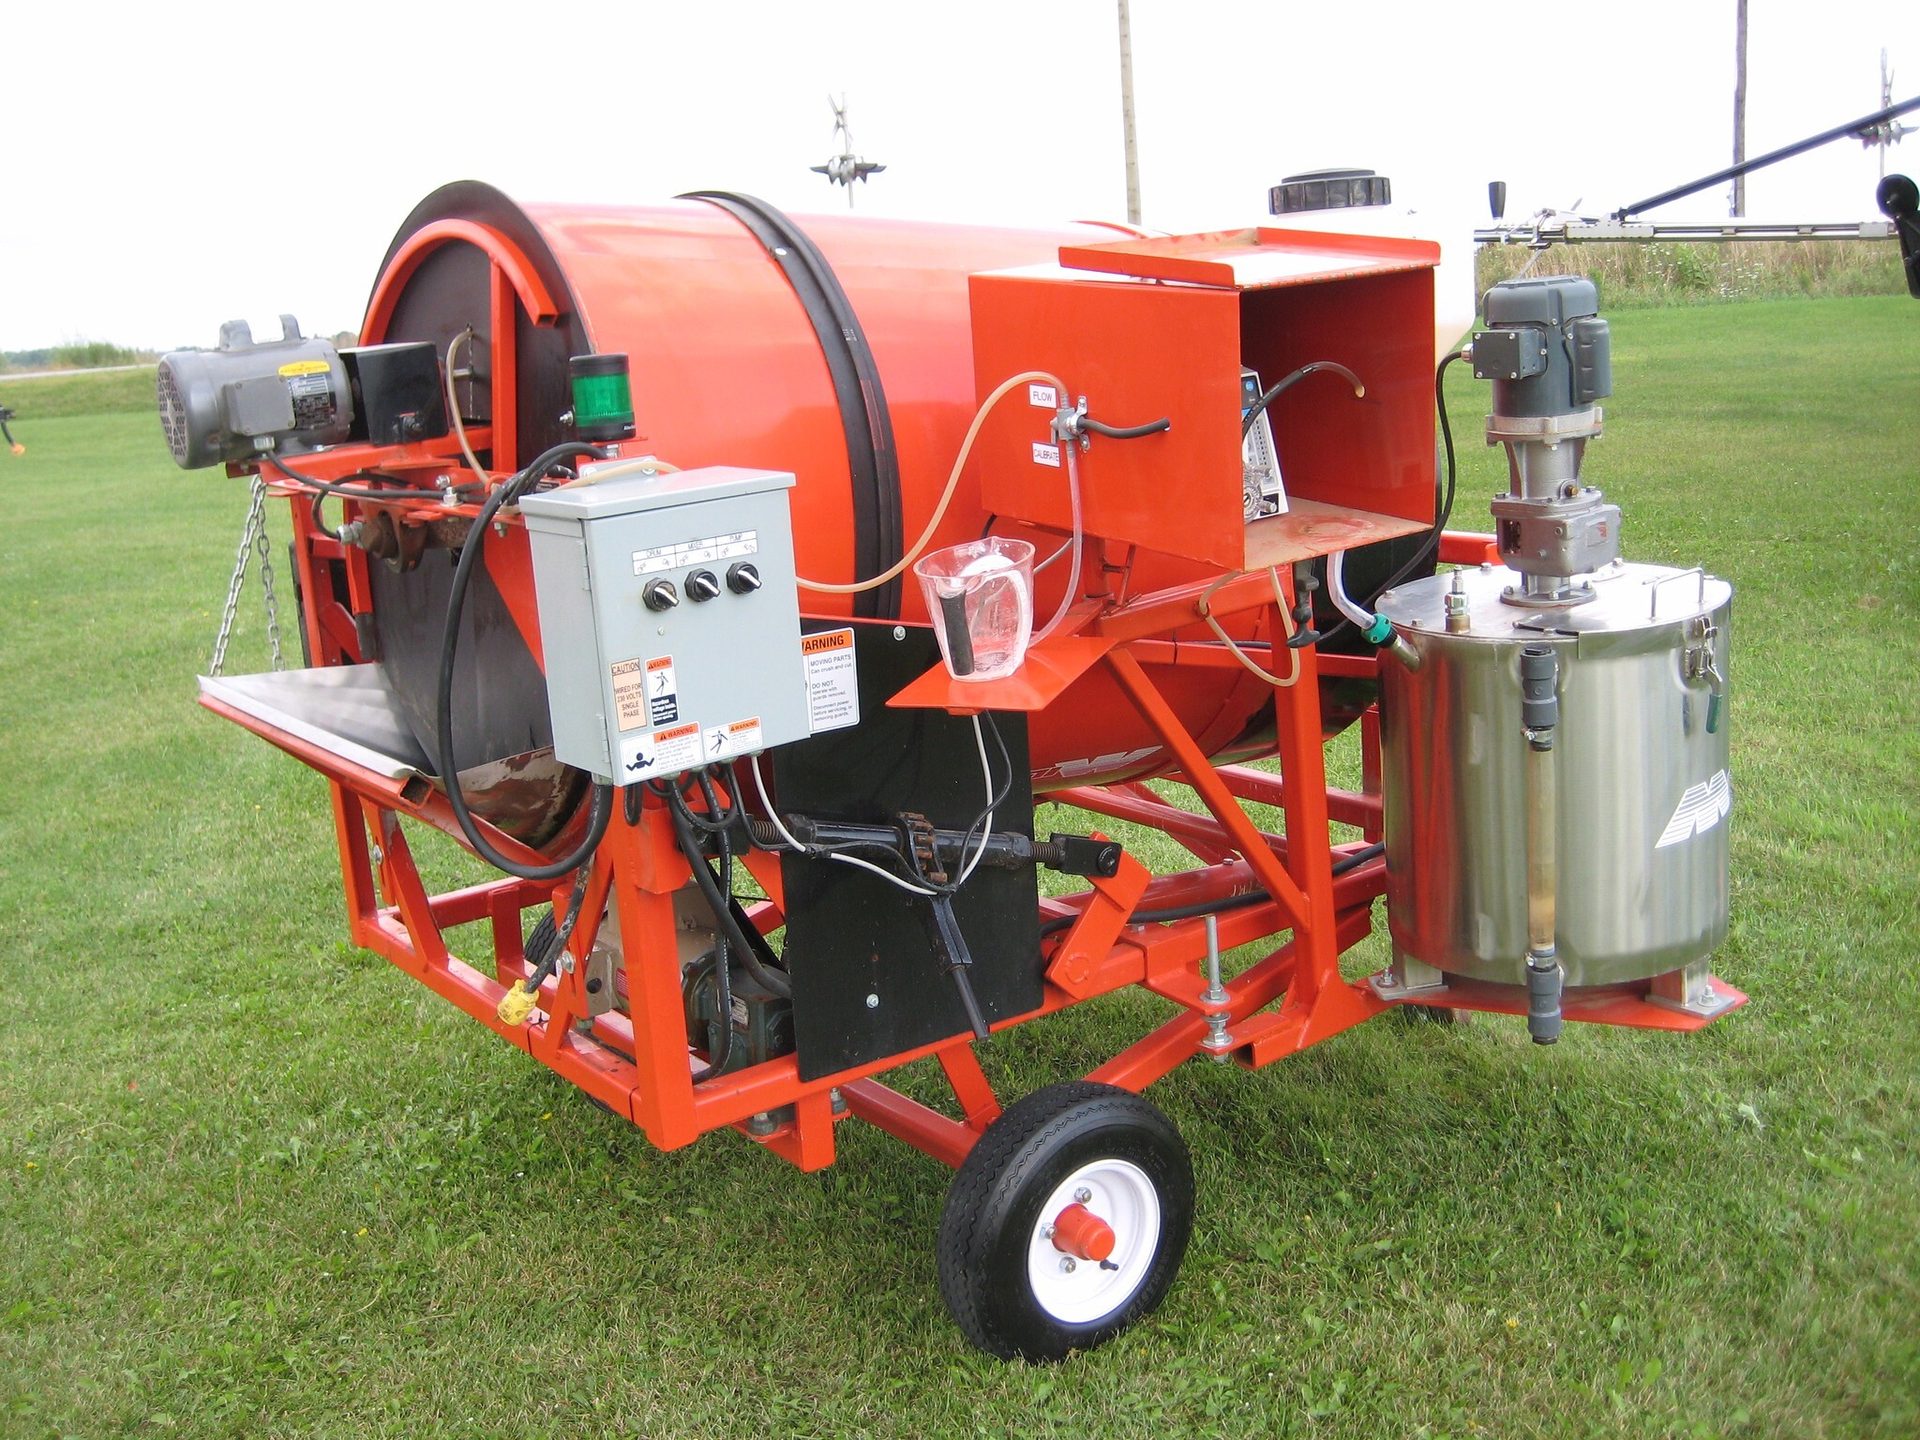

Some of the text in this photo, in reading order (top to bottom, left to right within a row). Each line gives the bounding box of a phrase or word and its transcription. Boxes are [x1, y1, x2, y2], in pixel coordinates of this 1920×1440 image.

[1033, 391, 1052, 402] FLOW
[802, 635, 844, 651] ARNING
[811, 654, 851, 666] MOVING PARTS
[612, 661, 640, 674] CAUTION
[615, 685, 631, 694] WIRED
[626, 692, 641, 700] VOLTS
[621, 701, 639, 711] SINGLE
[623, 710, 640, 718] PHASE
[735, 720, 757, 731] WARNING
[668, 726, 693, 738] WARNING
